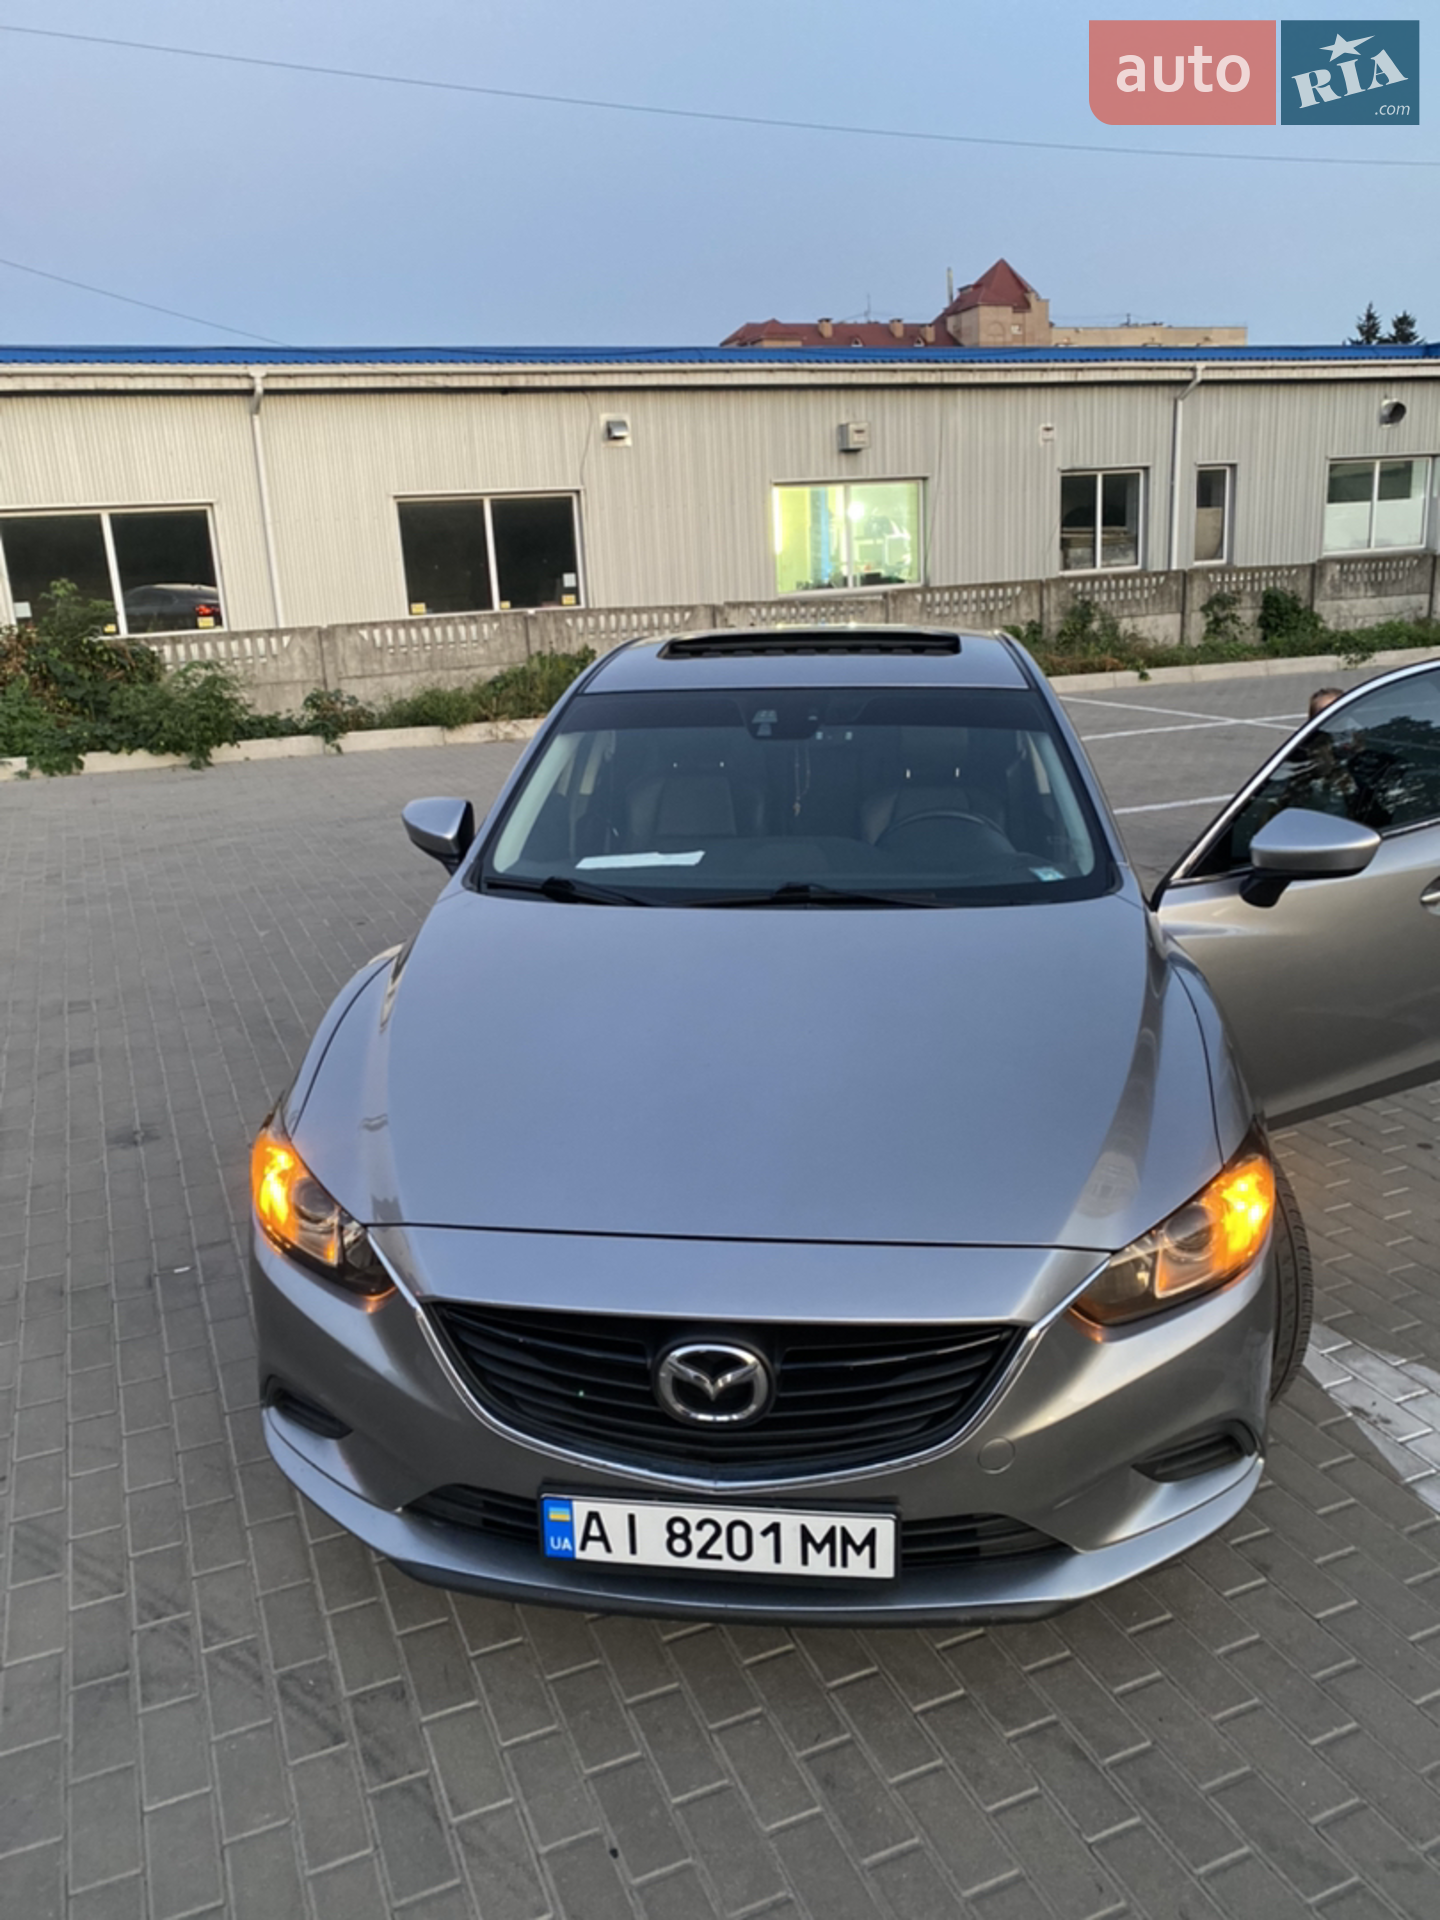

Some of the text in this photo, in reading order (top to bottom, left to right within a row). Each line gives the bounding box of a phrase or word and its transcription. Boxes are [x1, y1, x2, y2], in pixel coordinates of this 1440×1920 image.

[550, 1537, 572, 1551] UA
[579, 1511, 877, 1570] AI 8201 MM
